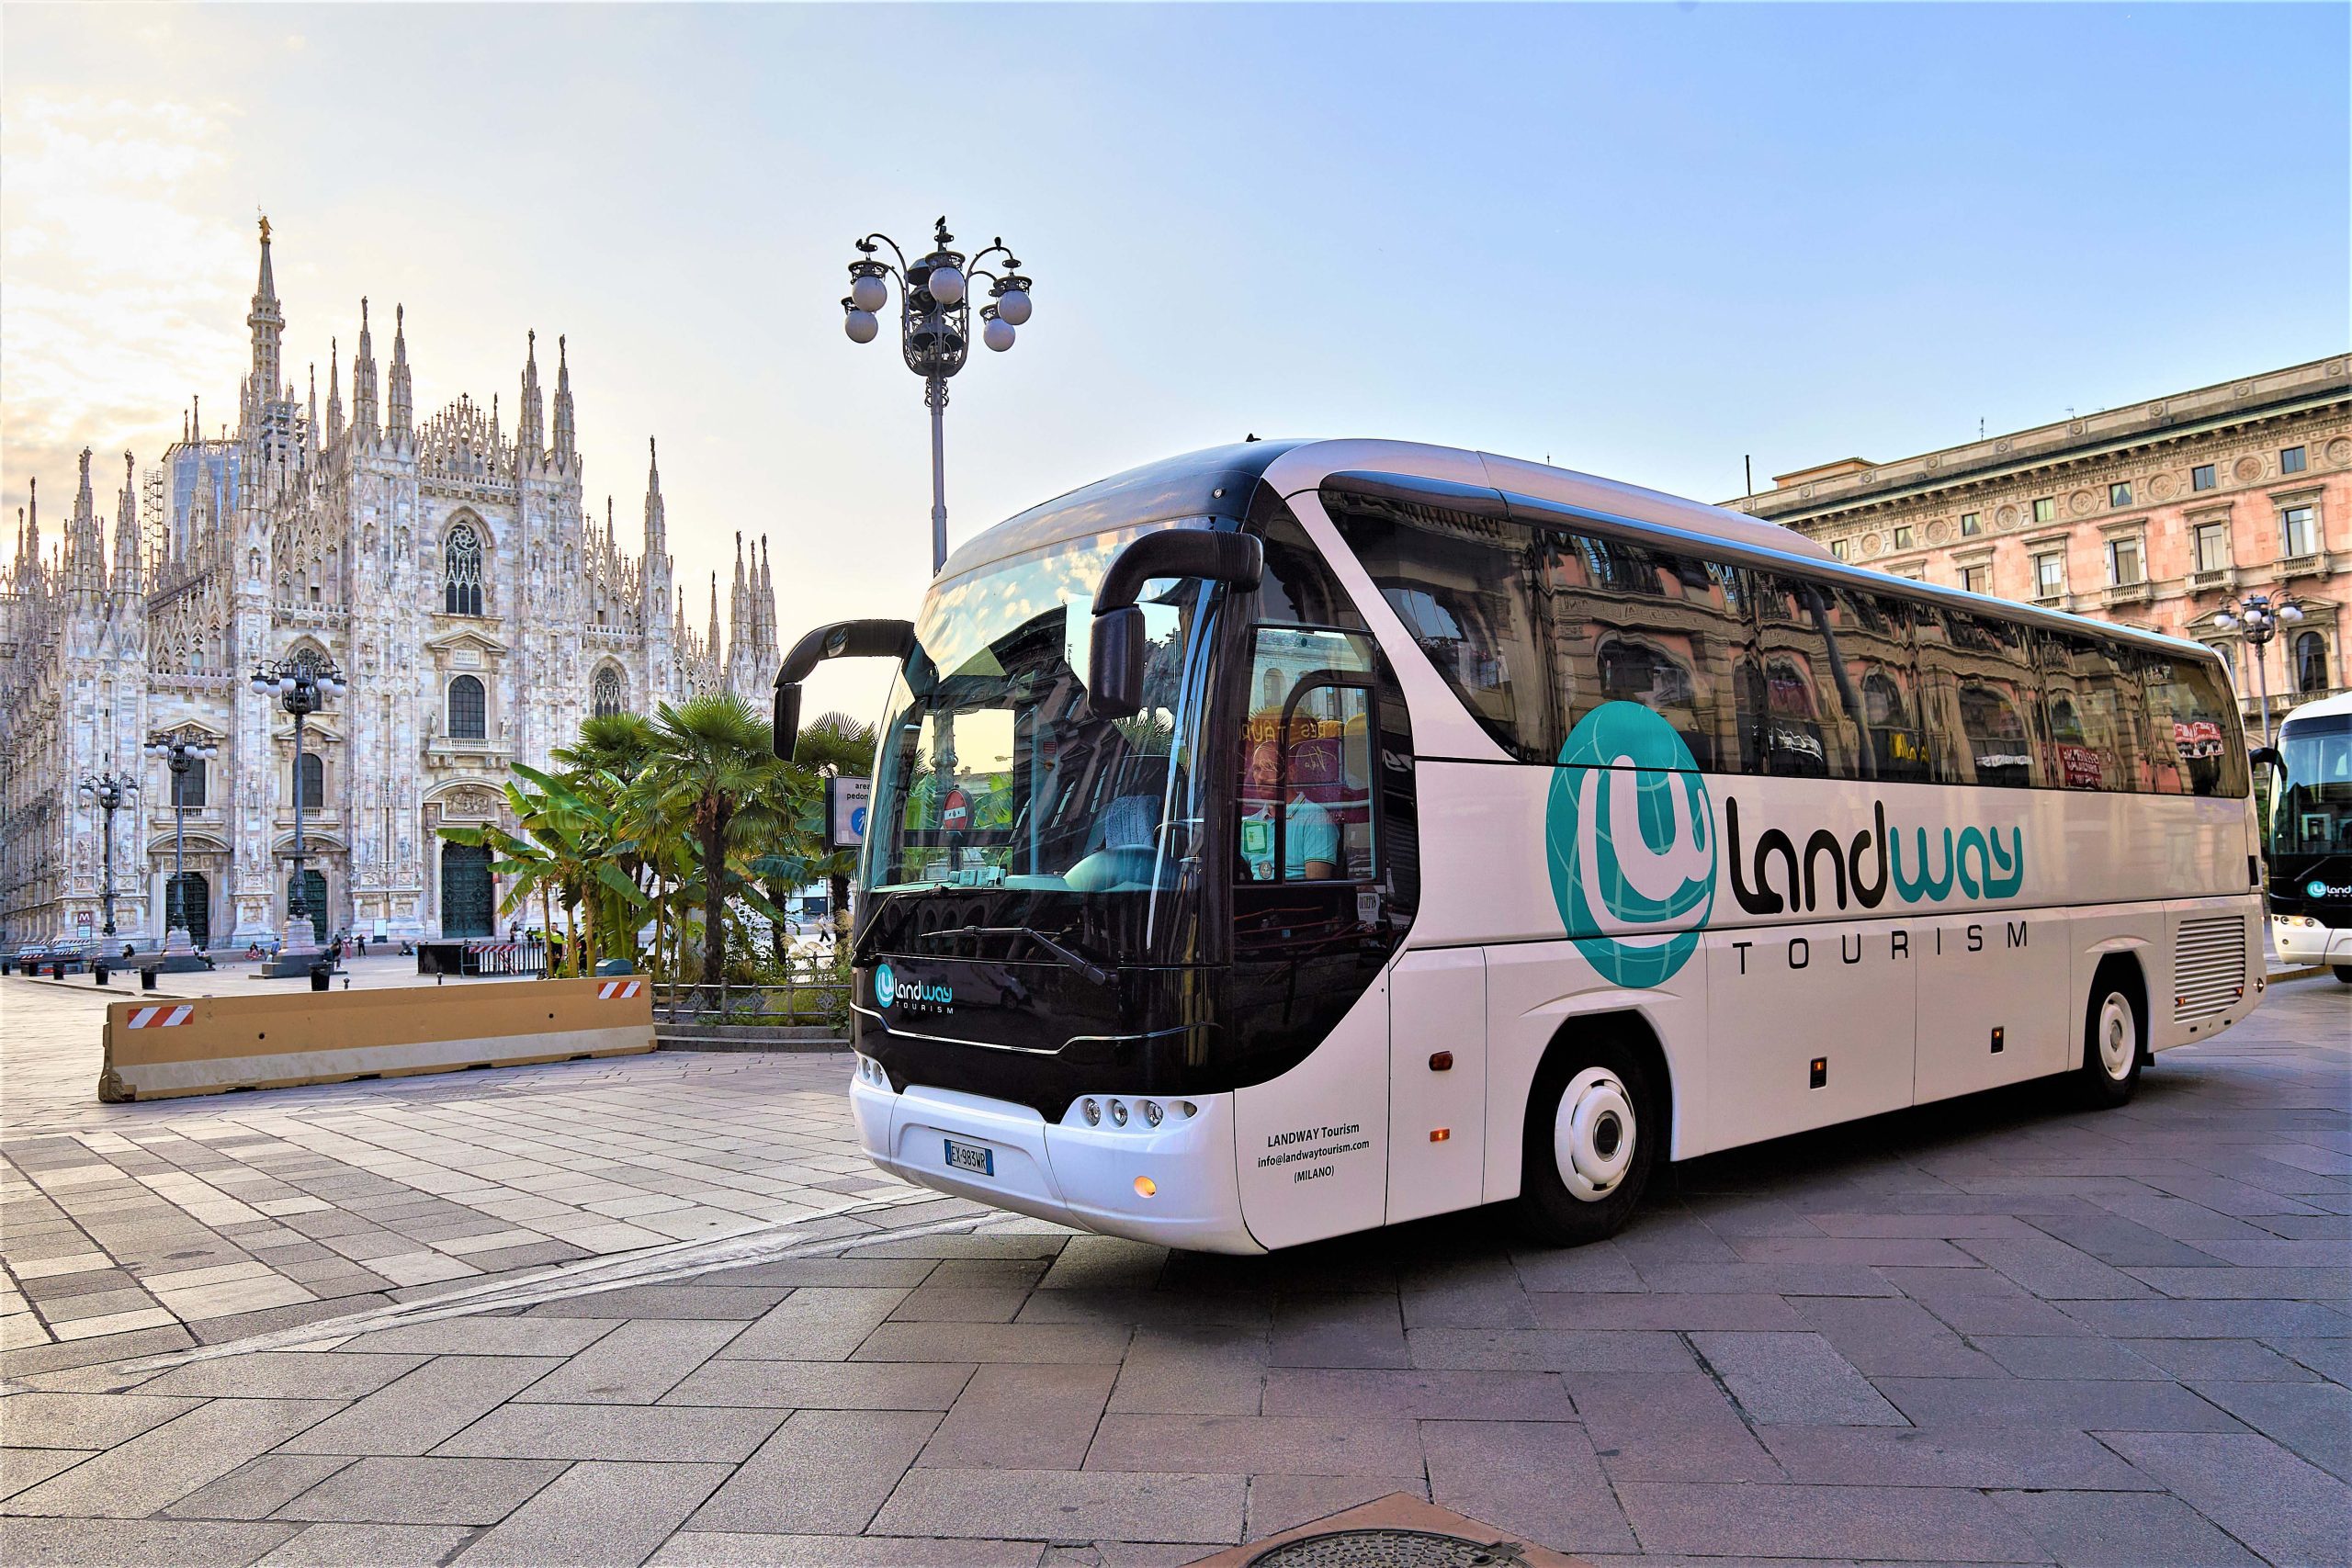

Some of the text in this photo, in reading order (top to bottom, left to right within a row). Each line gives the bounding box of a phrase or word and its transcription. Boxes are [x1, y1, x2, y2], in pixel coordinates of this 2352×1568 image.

[1725, 795, 2025, 915] landway
[78, 913, 90, 921] M
[1732, 920, 2028, 975] TOURISM
[894, 977, 953, 1003] landway
[896, 1000, 954, 1015] TOURISM
[1267, 1122, 1360, 1148] LANDWAY Tourism
[1258, 1140, 1370, 1168] info@landwaytourism.com
[1294, 1165, 1335, 1184] (MILANO)
